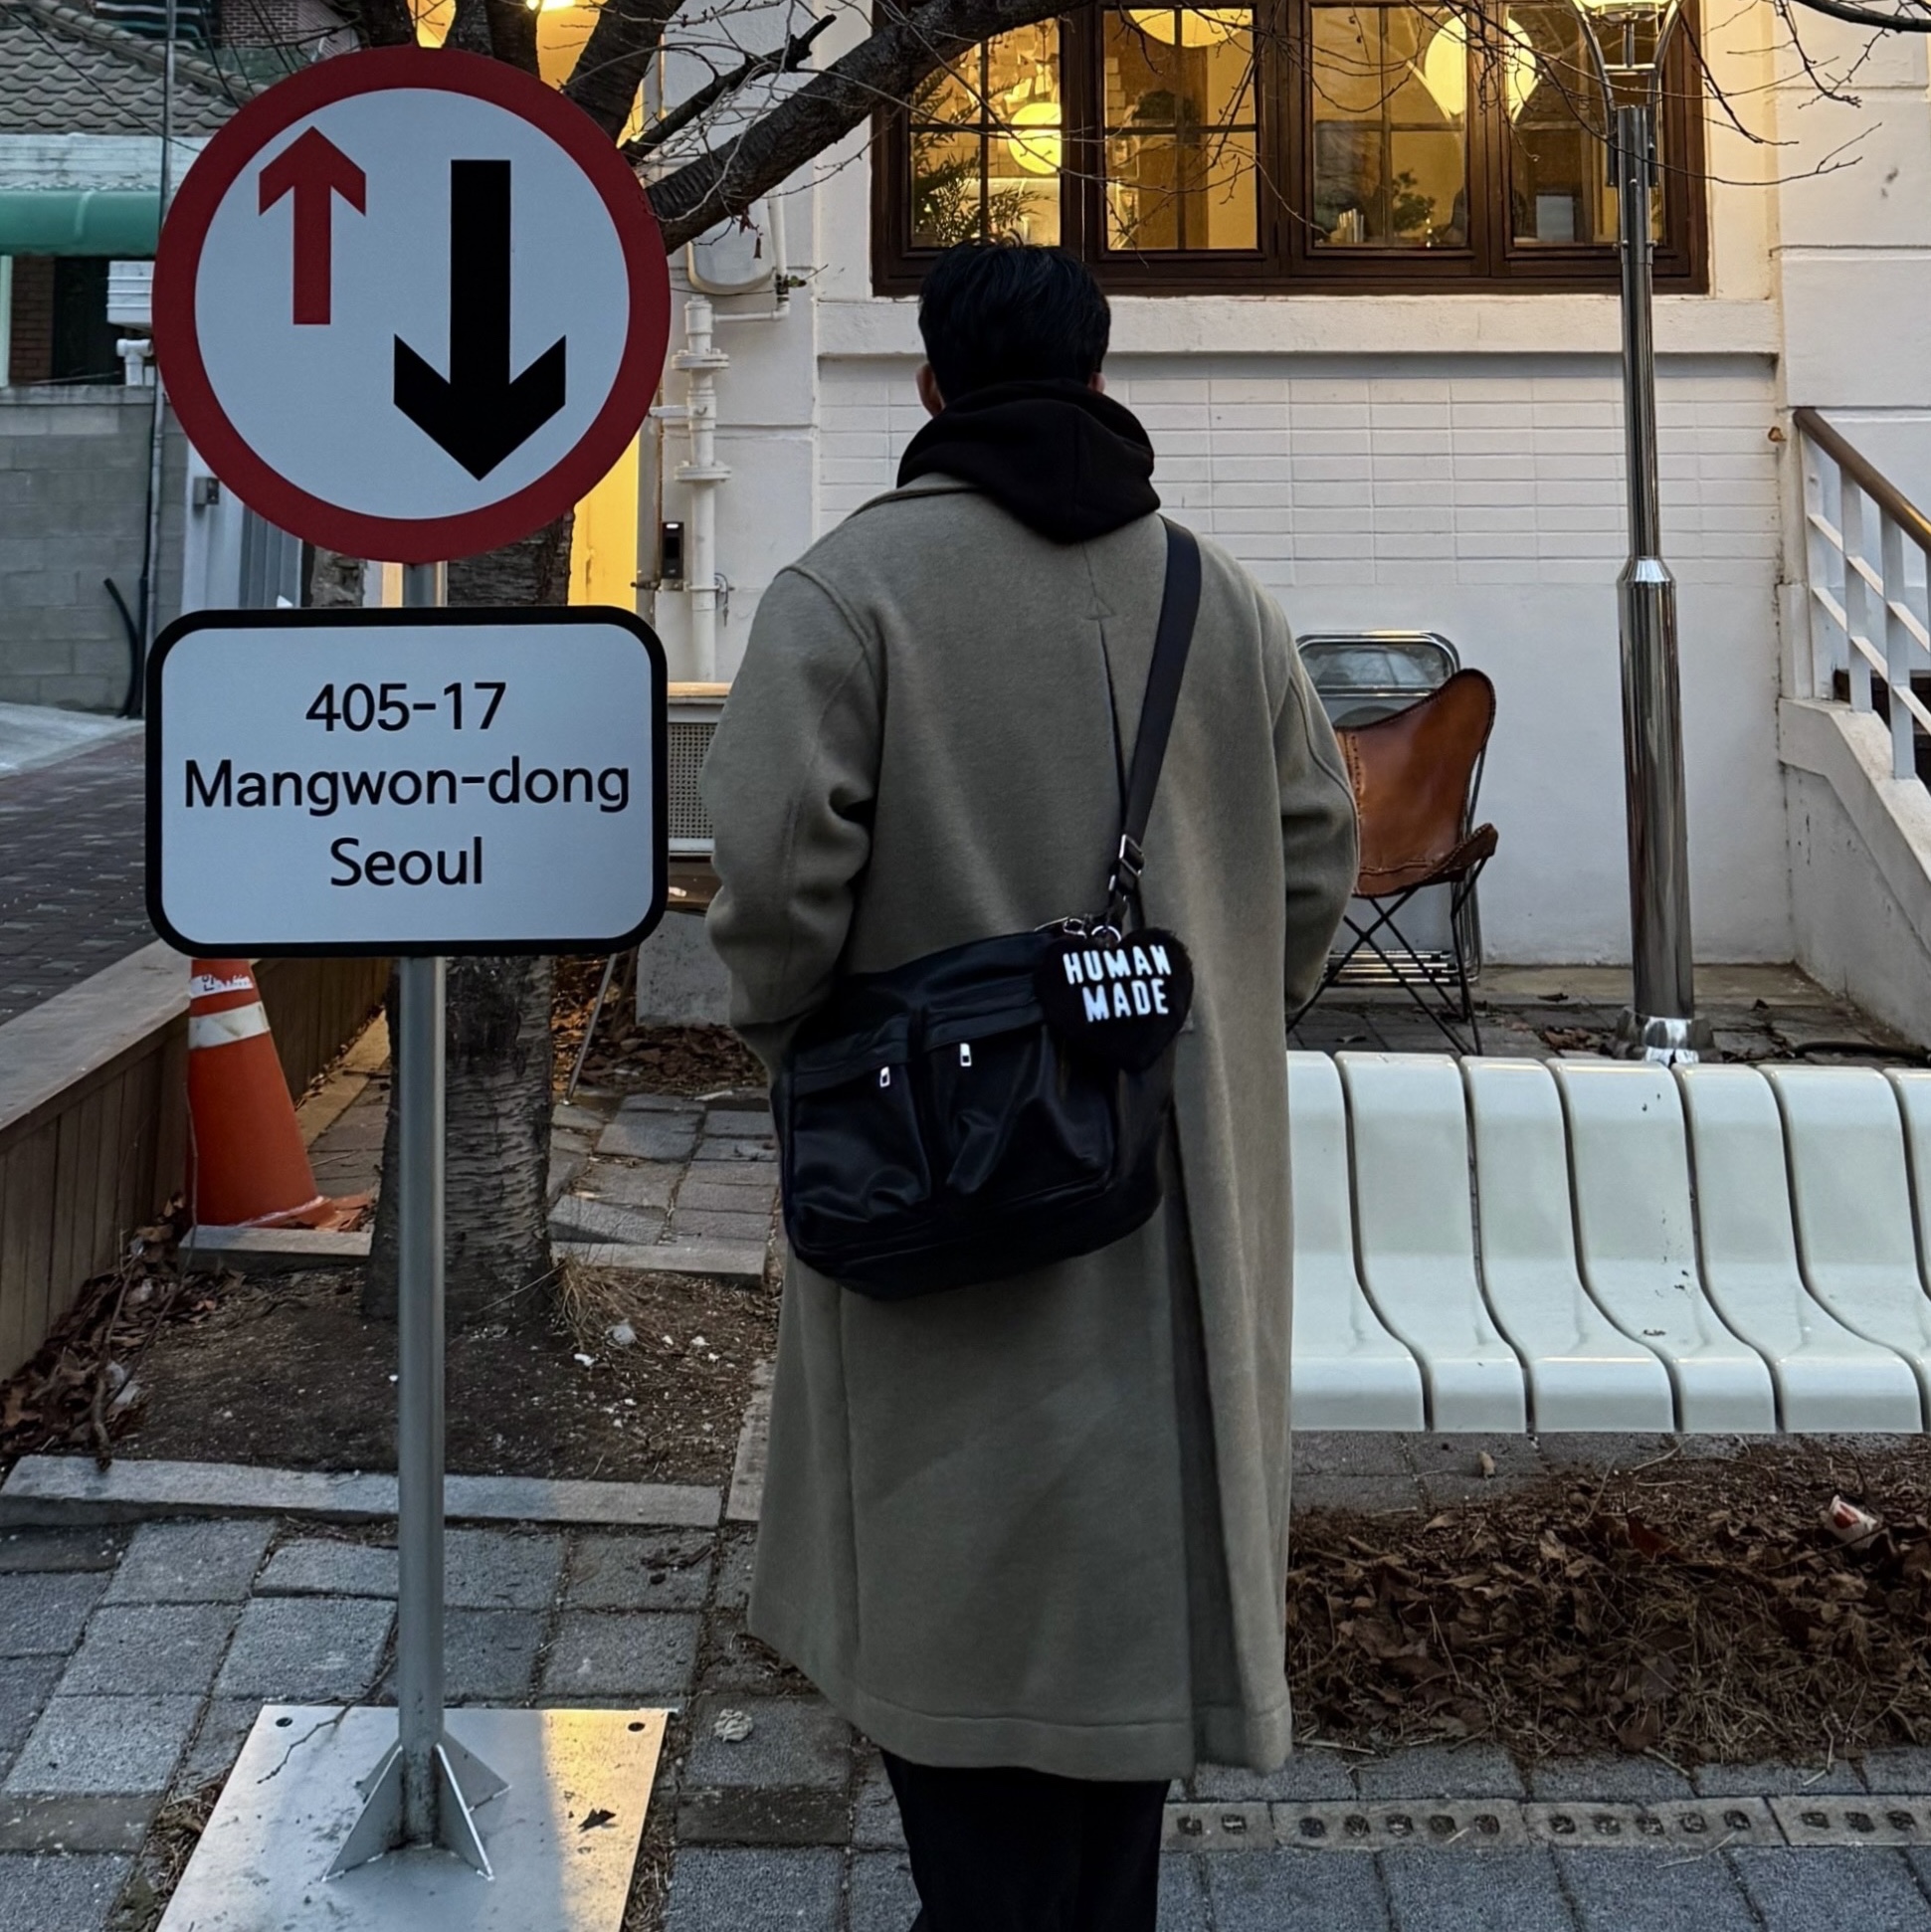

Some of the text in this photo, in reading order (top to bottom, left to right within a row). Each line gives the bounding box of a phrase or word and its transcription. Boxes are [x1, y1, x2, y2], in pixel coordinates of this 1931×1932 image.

[305, 681, 507, 732] 405-17
[185, 755, 630, 818] Mangwon-dong
[330, 836, 483, 887] Seoul
[1062, 944, 1172, 985] HUMAN
[1082, 978, 1169, 1023] MADE
